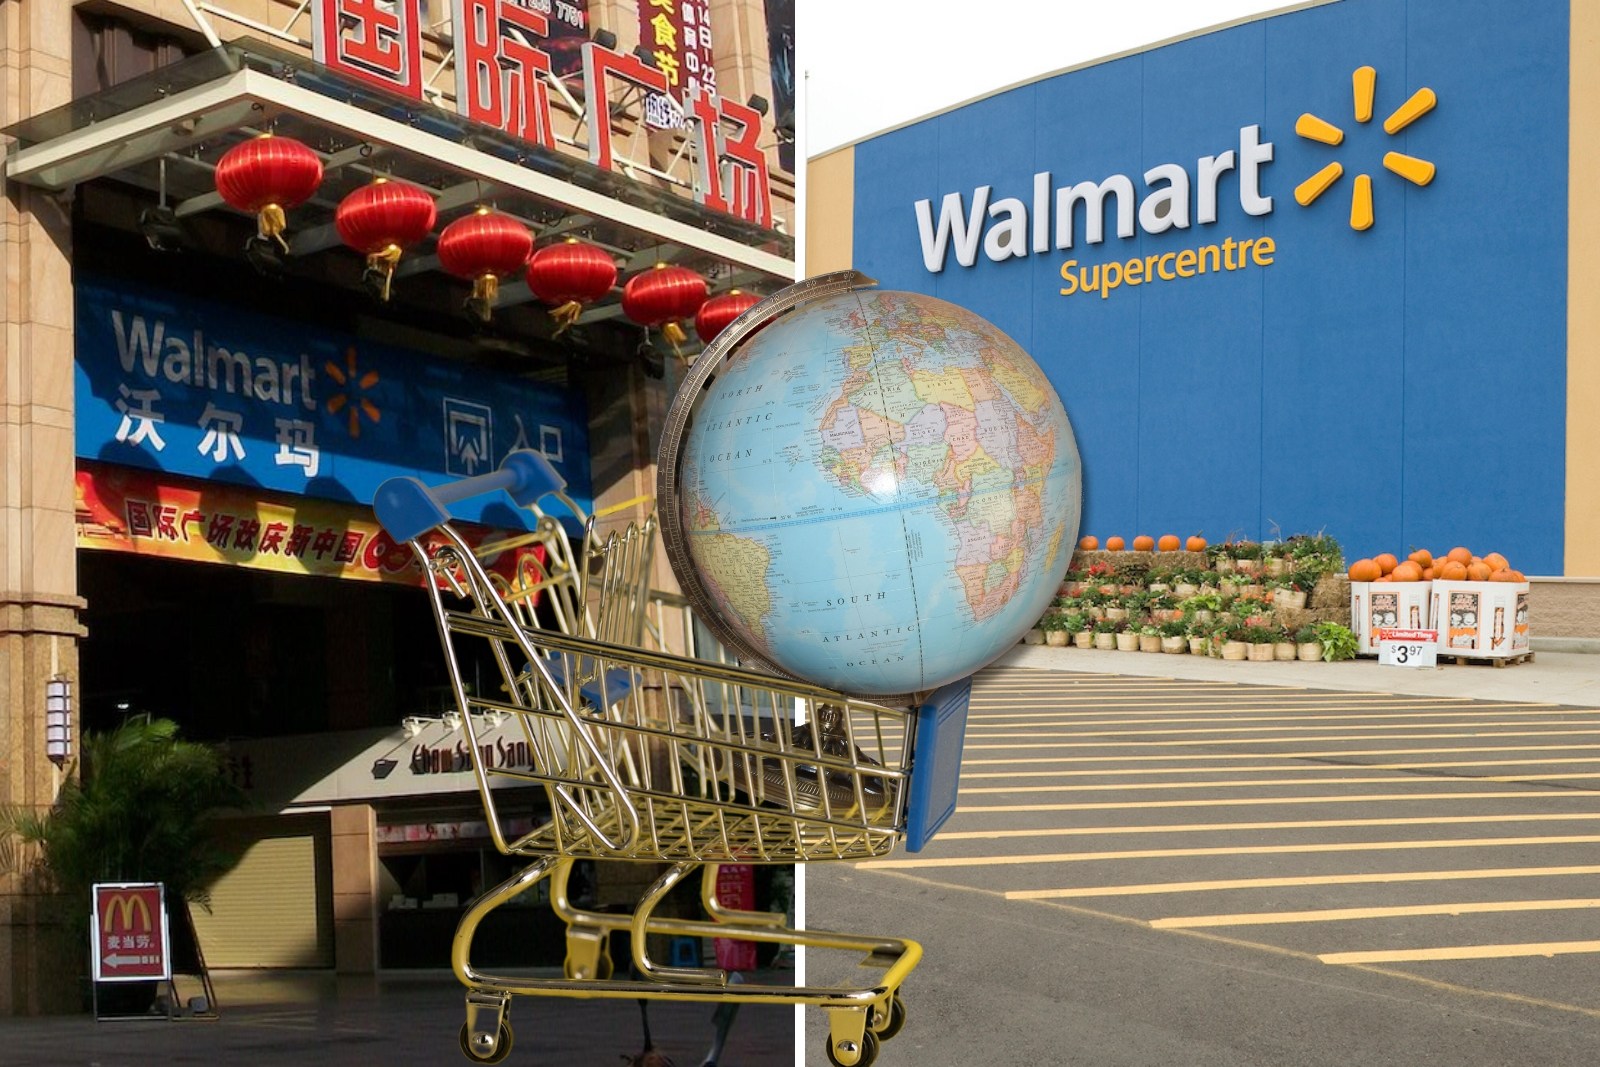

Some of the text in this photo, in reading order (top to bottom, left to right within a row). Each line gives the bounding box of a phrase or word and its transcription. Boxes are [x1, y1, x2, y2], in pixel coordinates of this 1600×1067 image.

[914, 124, 1274, 273] Walmart
[1060, 235, 1276, 299] Supercentre
[112, 309, 317, 412] Walmart
[720, 384, 763, 400] NORTH
[114, 383, 320, 478] 沃尔玛
[705, 412, 773, 433] ATLANTIC
[508, 413, 564, 464] 入口
[709, 448, 753, 463] OCEAN
[826, 591, 887, 607] SOUTH
[822, 625, 915, 643] ATLANTIC
[846, 655, 905, 667] OCEAN
